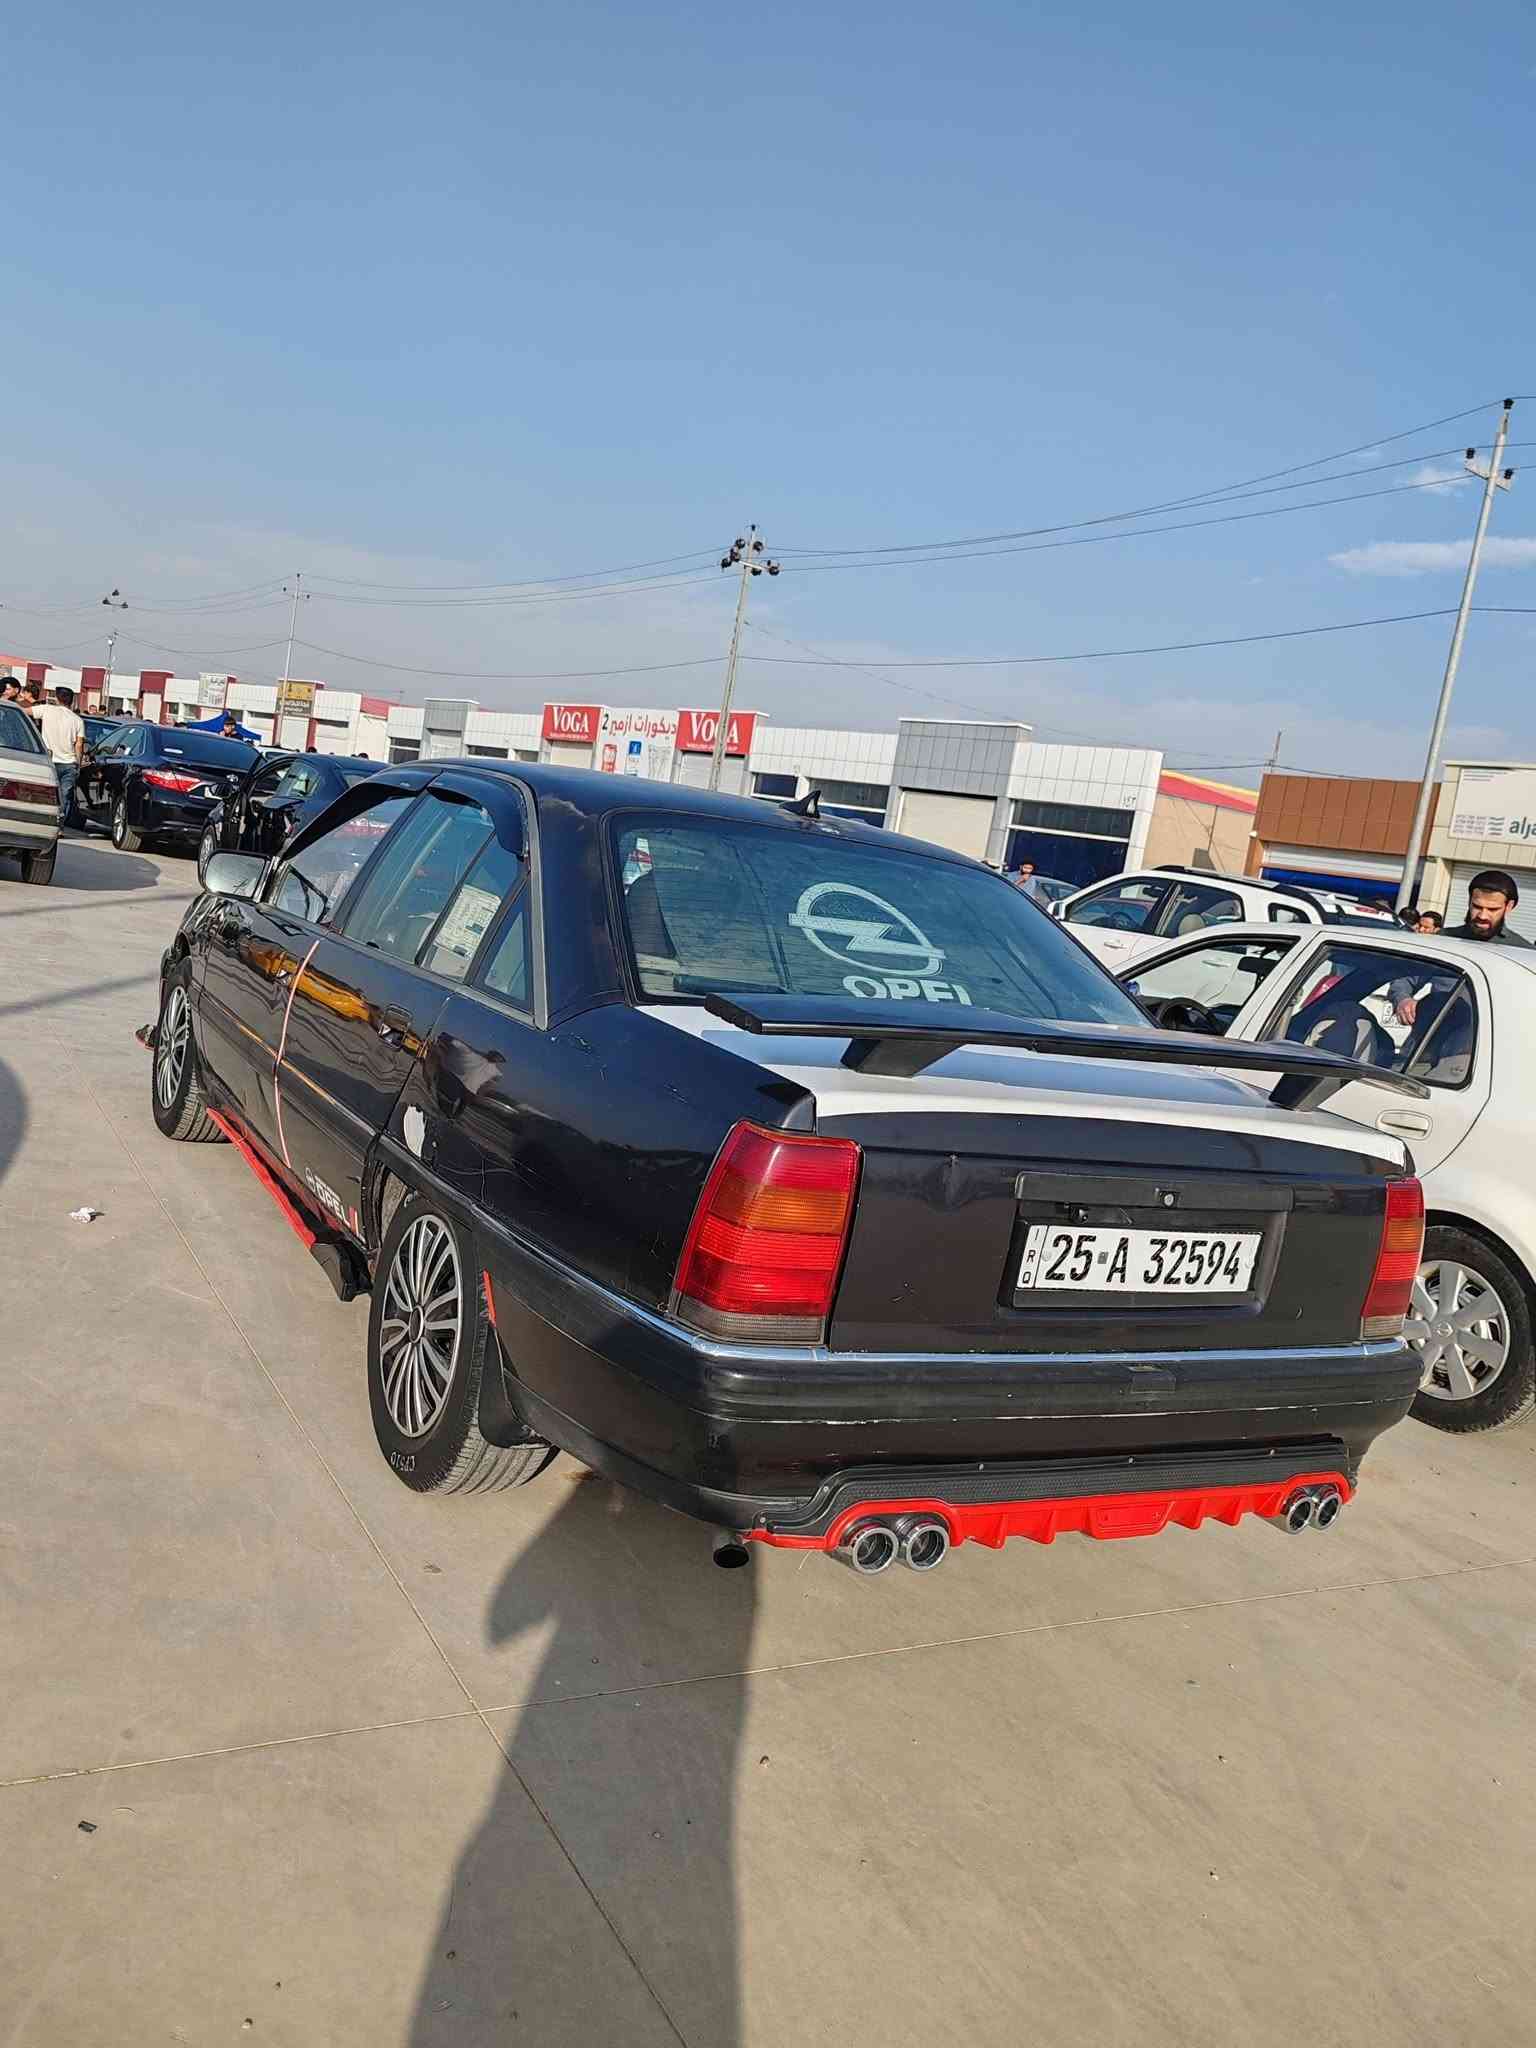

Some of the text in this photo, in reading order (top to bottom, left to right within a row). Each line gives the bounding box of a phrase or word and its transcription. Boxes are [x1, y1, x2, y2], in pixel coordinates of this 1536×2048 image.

[553, 706, 589, 733] VOGA
[602, 713, 609, 730] 2
[634, 714, 677, 739] ديكورات
[1022, 1228, 1040, 1285] IRQ
[1045, 1234, 1242, 1285] 25 A 32594
